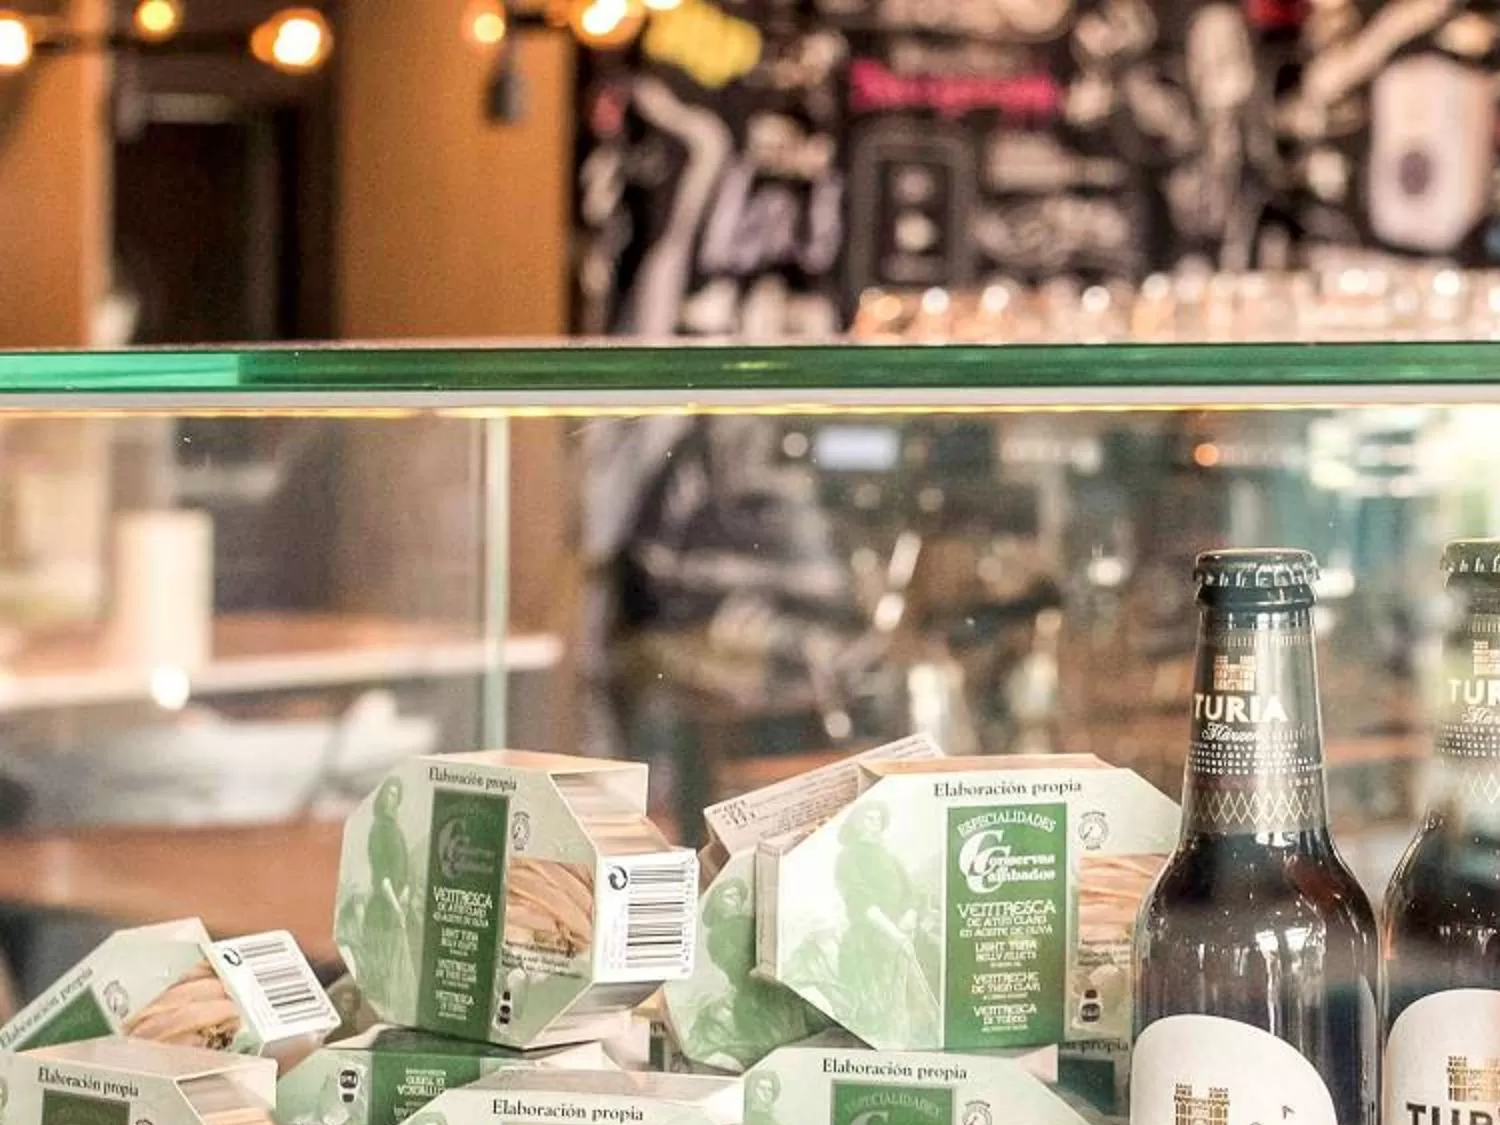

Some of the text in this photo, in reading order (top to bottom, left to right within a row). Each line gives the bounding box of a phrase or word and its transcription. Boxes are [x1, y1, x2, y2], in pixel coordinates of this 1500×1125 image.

[1194, 692, 1288, 723] TURIA
[933, 778, 1083, 799] Elaboración propia
[956, 809, 1057, 840] ESPECIALIDADES
[956, 898, 1057, 919] VENTRESCA
[822, 1056, 968, 1081] Elaboración propia
[102, 1080, 139, 1098] propia
[491, 1098, 644, 1124] Elaboración propia
